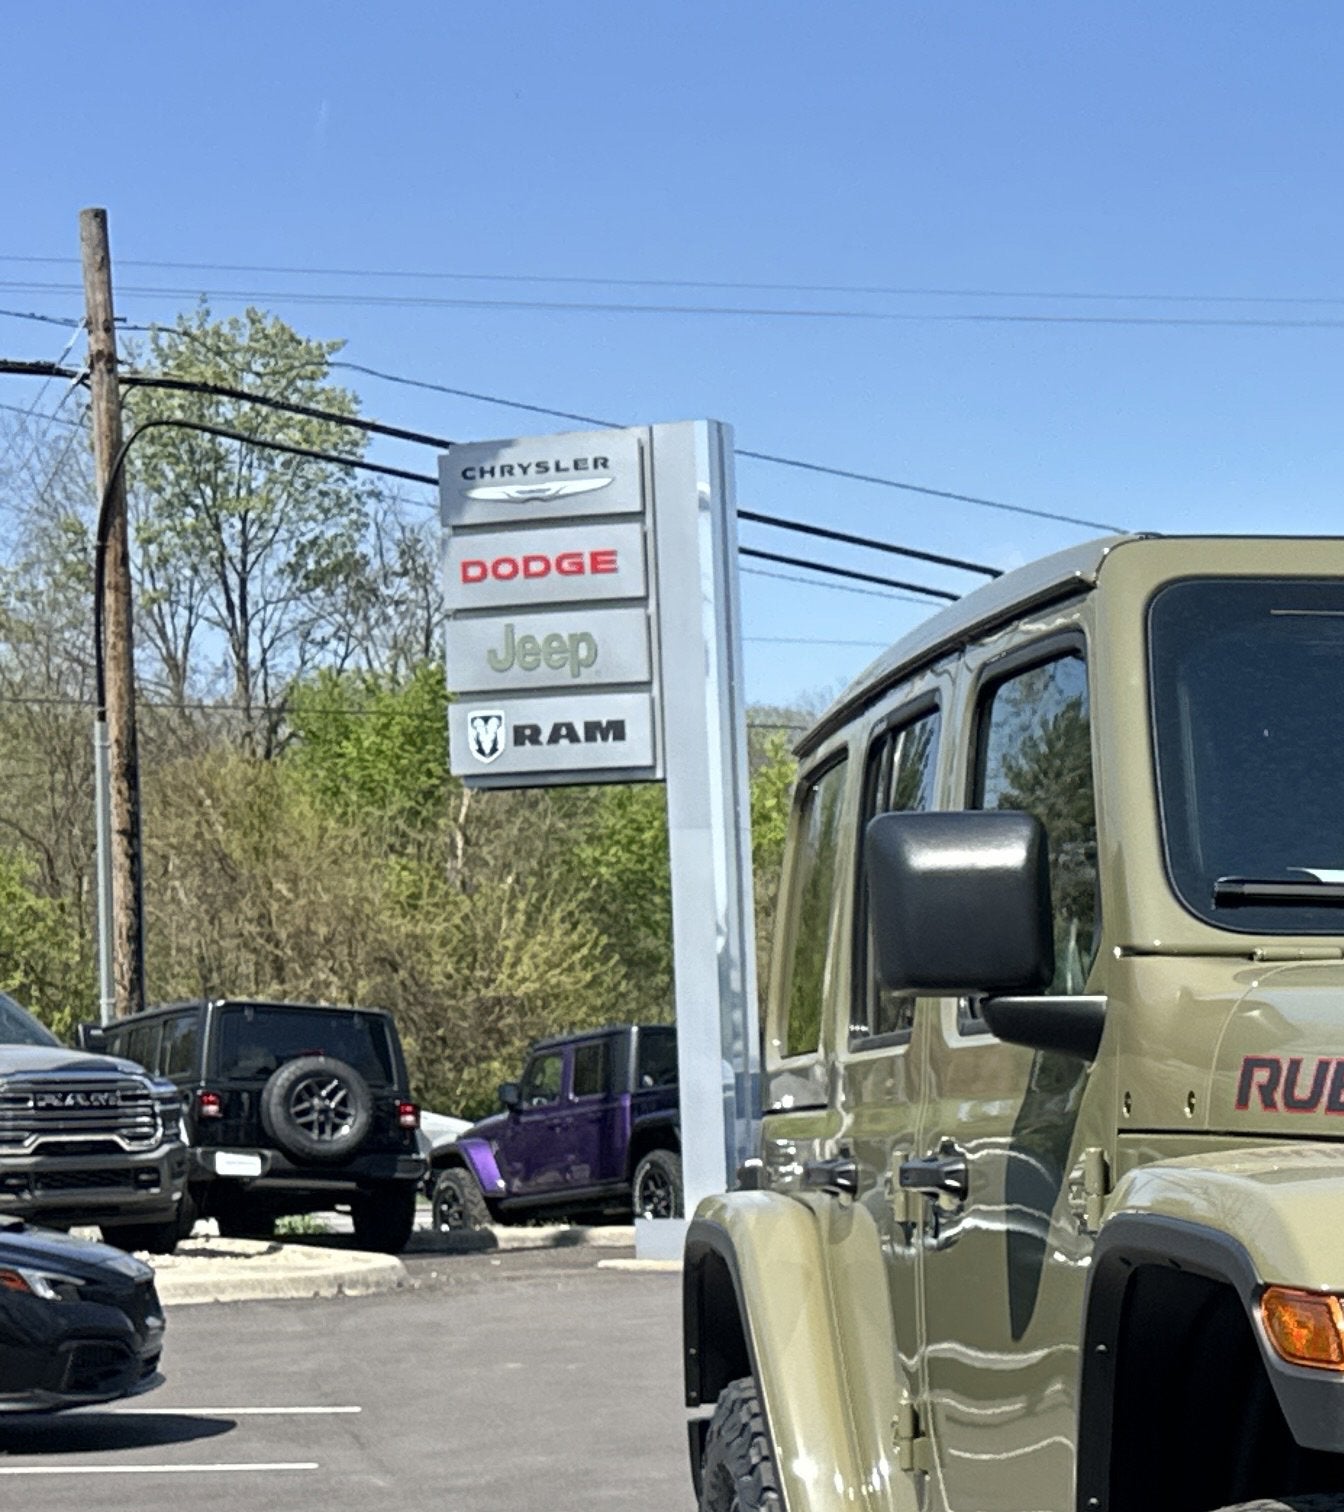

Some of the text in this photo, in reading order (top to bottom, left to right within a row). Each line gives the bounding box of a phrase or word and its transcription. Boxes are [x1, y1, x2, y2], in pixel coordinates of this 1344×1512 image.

[460, 455, 611, 481] CHRYSLER
[460, 548, 619, 584] DODGE
[487, 622, 598, 678] Jeep
[512, 719, 627, 748] RAM
[36, 1092, 121, 1107] RAM
